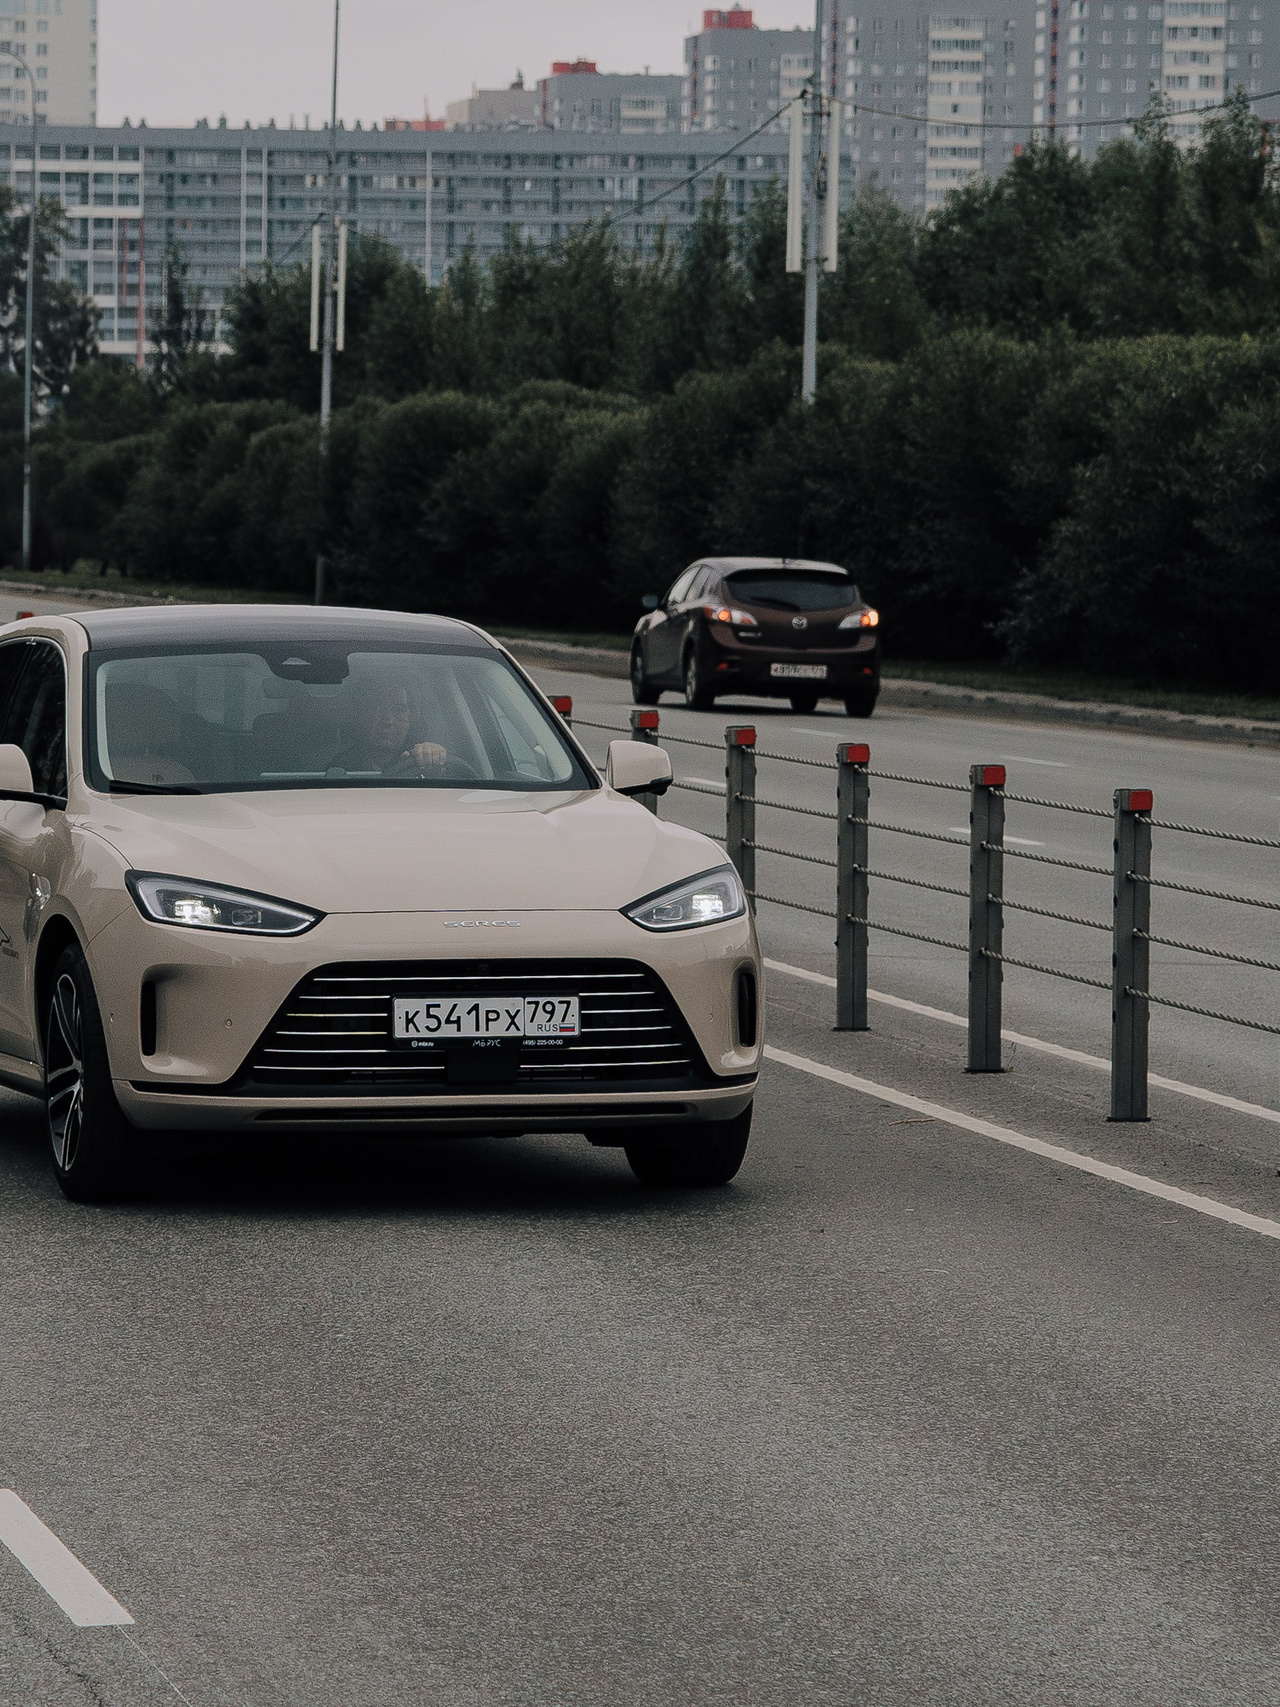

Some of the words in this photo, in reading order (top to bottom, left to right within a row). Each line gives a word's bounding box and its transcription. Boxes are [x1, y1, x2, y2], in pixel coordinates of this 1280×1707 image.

[443, 920, 521, 928] SERES
[404, 1002, 522, 1033] К541РХ
[526, 1000, 572, 1023] 797
[536, 1023, 558, 1032] RUS
